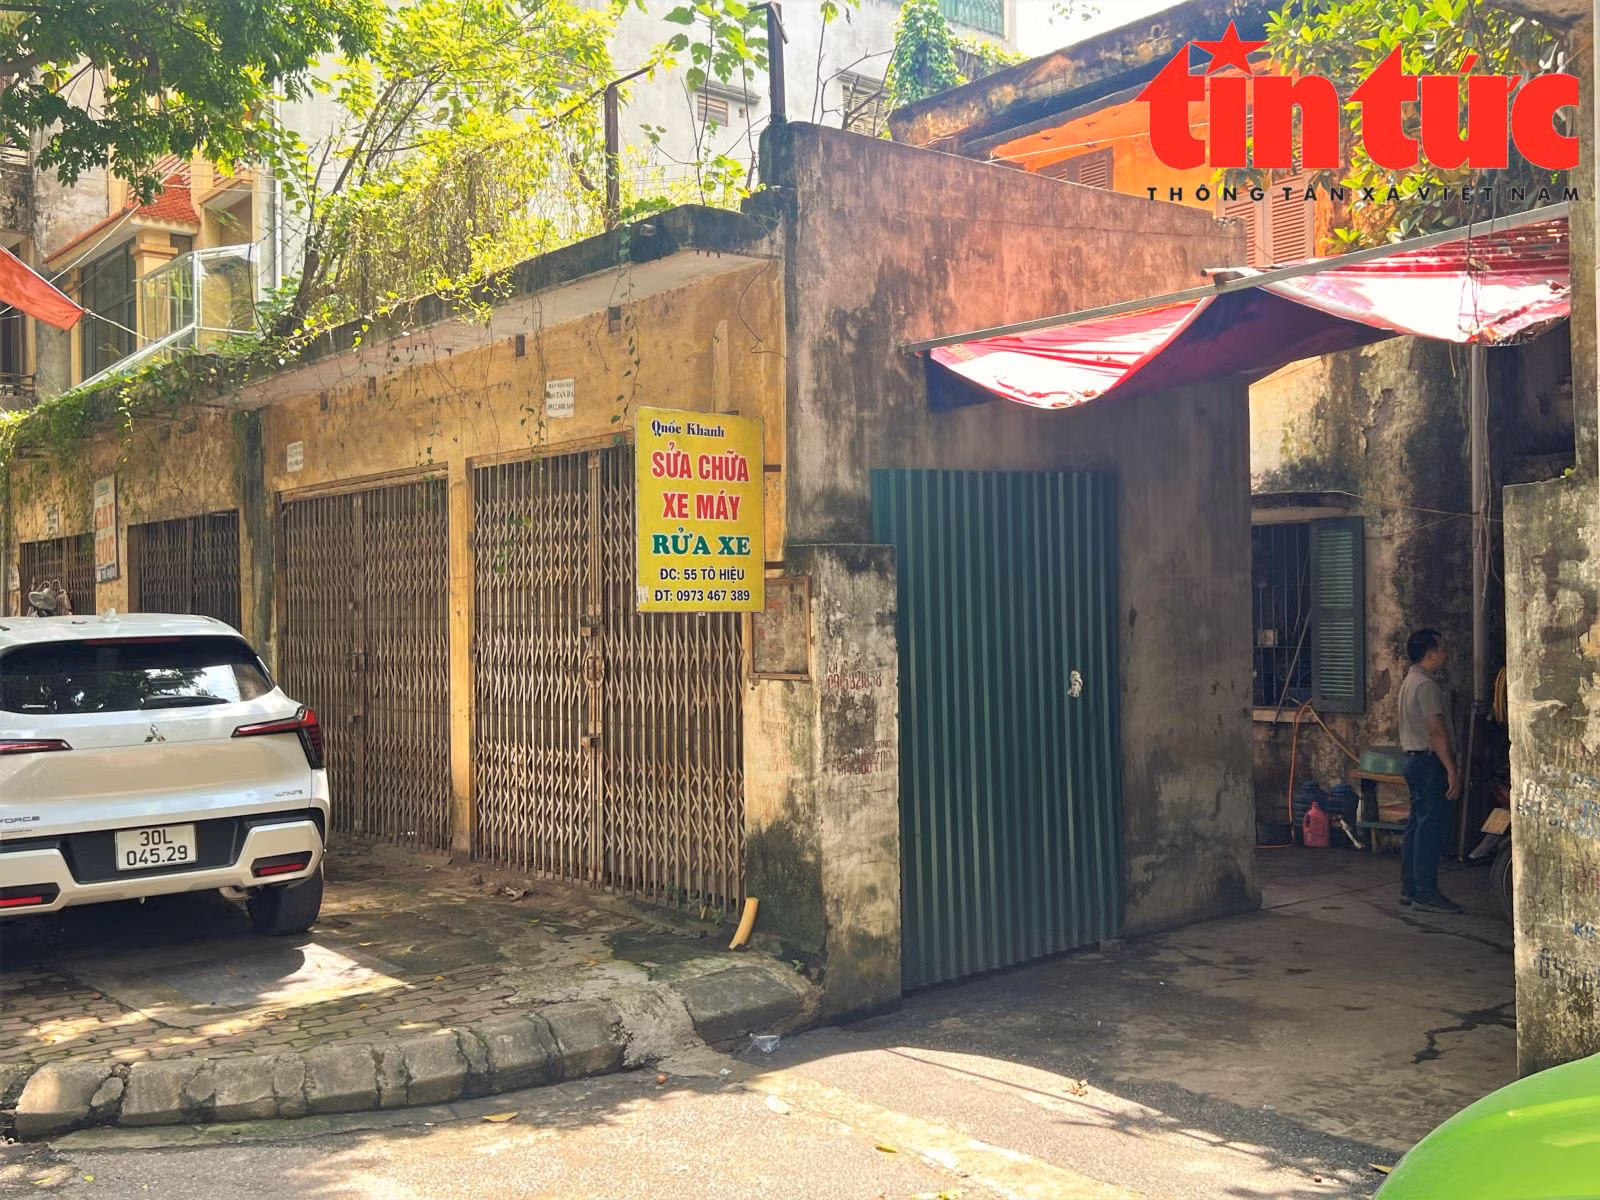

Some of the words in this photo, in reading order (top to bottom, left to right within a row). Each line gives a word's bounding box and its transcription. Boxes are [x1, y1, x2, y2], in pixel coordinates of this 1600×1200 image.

[651, 419, 682, 437] Quốc
[686, 422, 725, 438] Khanh
[652, 441, 693, 479] SỬA
[698, 450, 750, 482] CHỮA
[663, 492, 689, 519] XE
[696, 490, 740, 520] MÁY
[652, 527, 711, 555] RỬA
[718, 535, 751, 556] XE
[660, 568, 680, 581] ĐC:
[683, 568, 698, 581] 55
[701, 566, 716, 581] TÔ
[719, 566, 745, 584] HIỆU
[655, 589, 673, 602] ĐT:
[676, 589, 704, 602] 0973
[707, 590, 728, 602] 467
[730, 590, 751, 602] 389
[139, 830, 173, 847] 30L
[126, 846, 188, 866] 045.29
